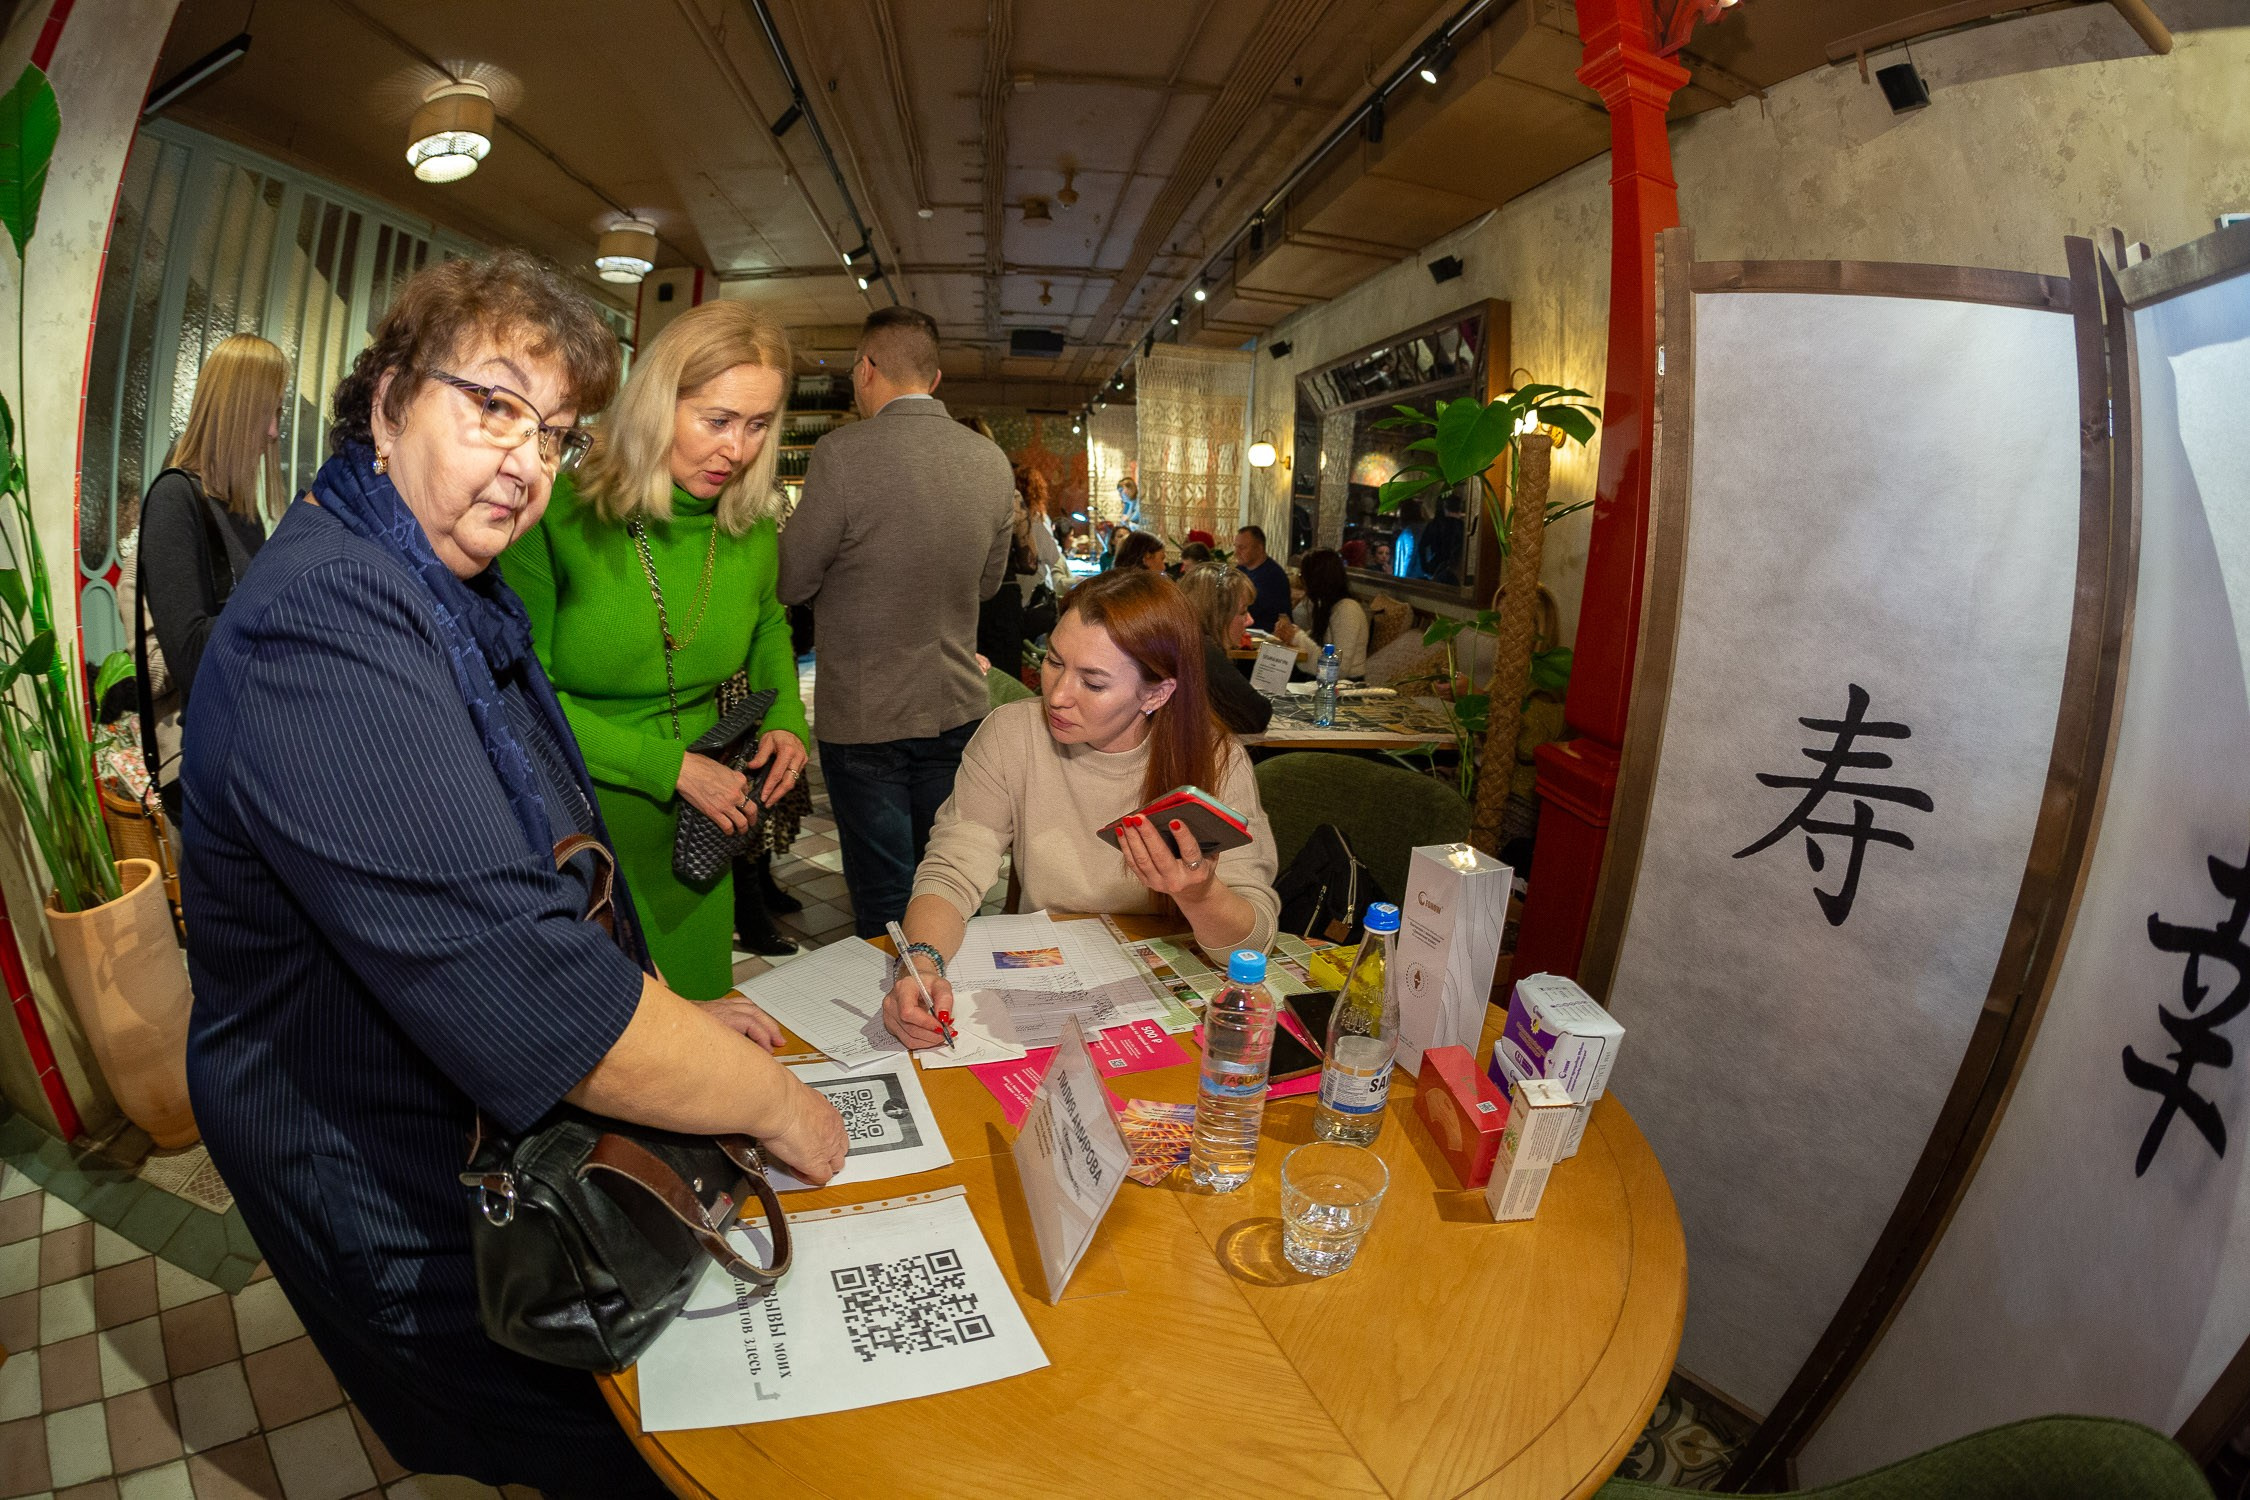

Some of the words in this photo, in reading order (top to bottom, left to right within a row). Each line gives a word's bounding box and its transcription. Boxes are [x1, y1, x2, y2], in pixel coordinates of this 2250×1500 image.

[1731, 682, 1934, 927] 寿
[1140, 1025, 1158, 1038] 500
[1057, 1070, 1077, 1117] ЛИЛИЯ
[1072, 1113, 1103, 1187] АМИРОВА
[733, 1276, 754, 1334] лиентов
[744, 1337, 762, 1377] здесь
[761, 1283, 787, 1337] ТЗЫВЫ
[773, 1342, 792, 1379] моих
